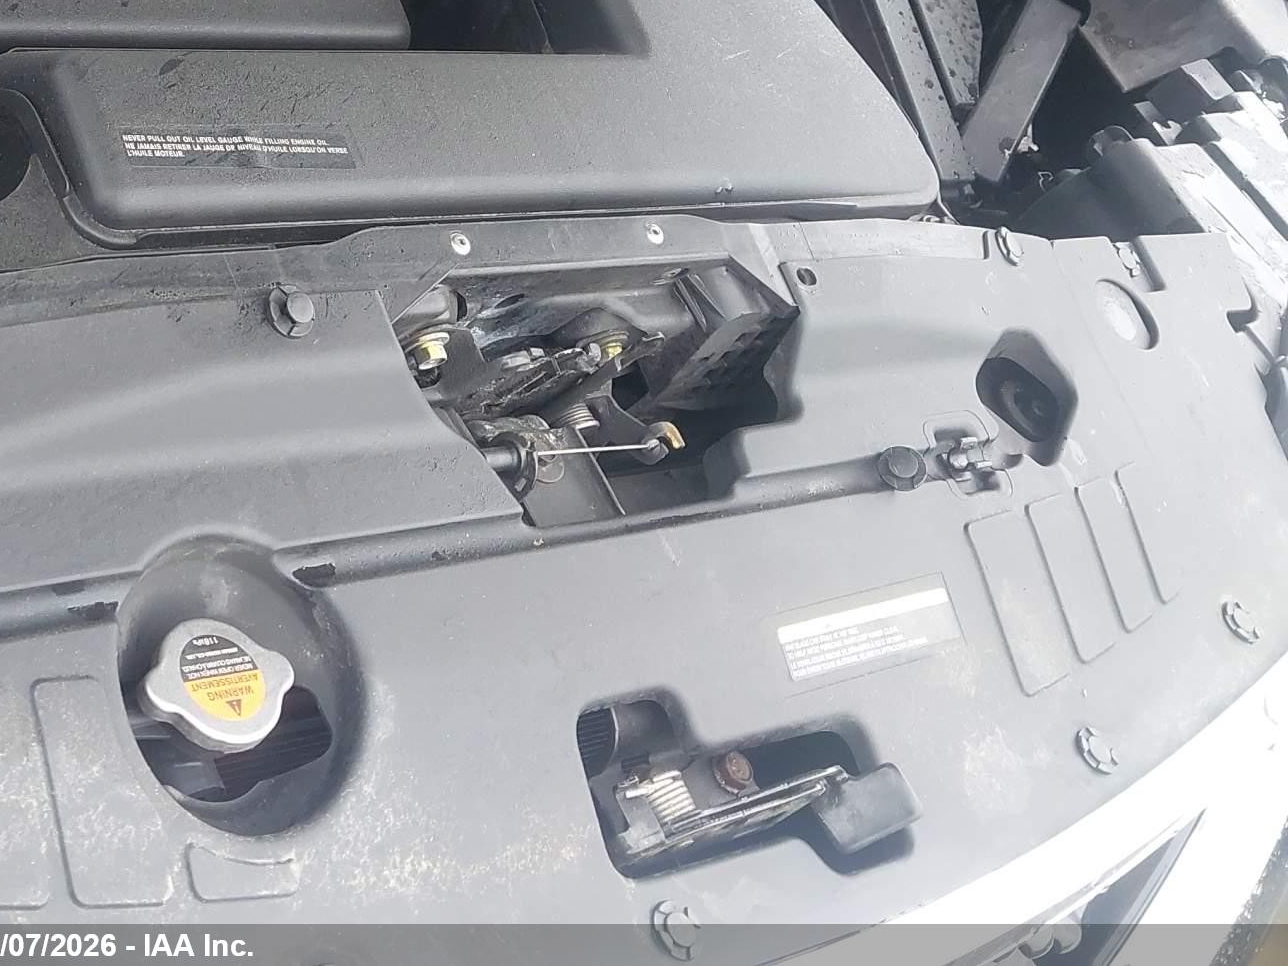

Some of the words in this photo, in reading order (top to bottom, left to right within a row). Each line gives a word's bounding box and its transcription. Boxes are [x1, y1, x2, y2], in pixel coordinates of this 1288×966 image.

[122, 134, 146, 142] NEVER
[147, 135, 166, 143] PULL
[166, 135, 181, 143] OUT
[183, 135, 194, 143] OIL
[244, 136, 263, 144] WHILE
[264, 137, 289, 145] FILLING
[291, 138, 316, 146] ENGINE
[237, 144, 262, 152] NIVEAU
[262, 145, 288, 153] D'HUILE
[191, 673, 258, 692] AVERTISSEMENT
[207, 685, 254, 701] WARNING
